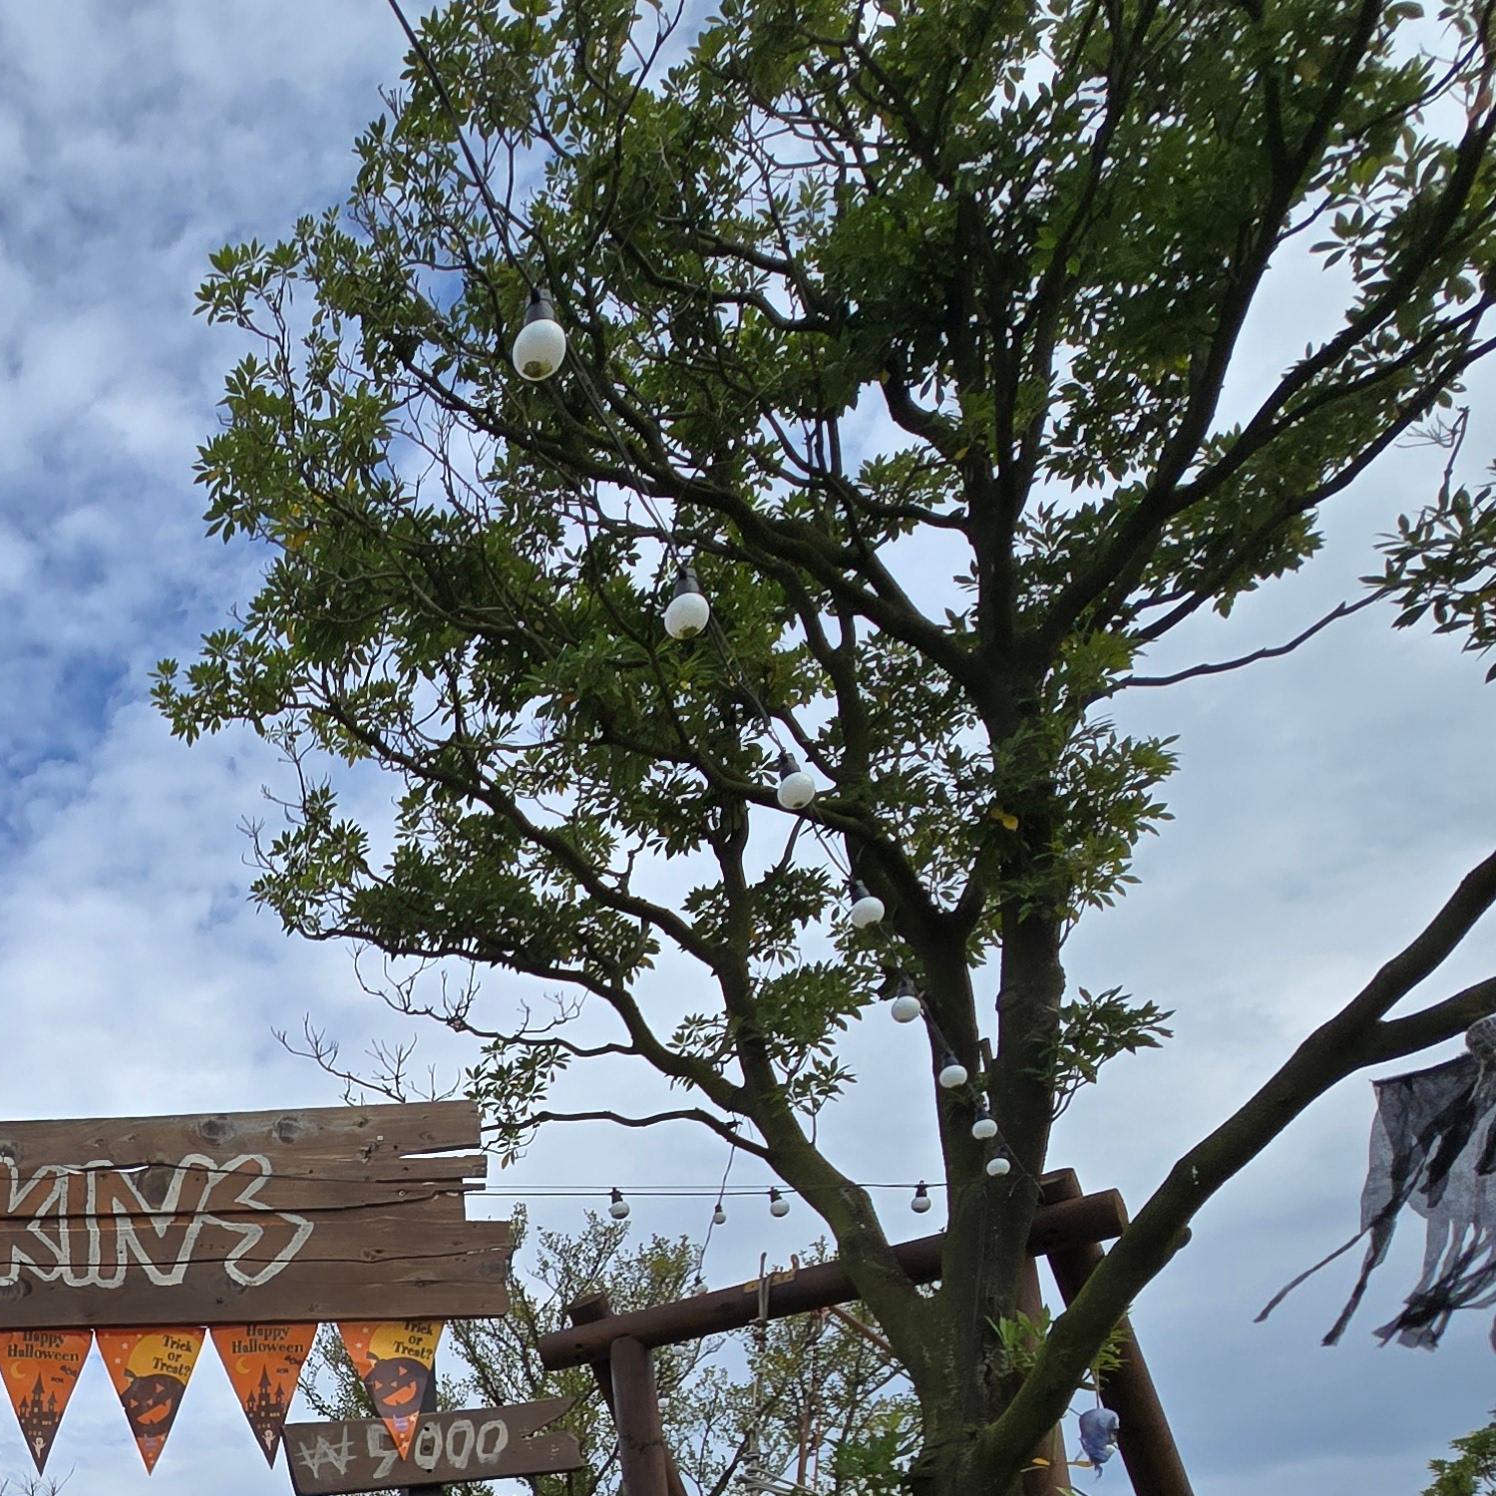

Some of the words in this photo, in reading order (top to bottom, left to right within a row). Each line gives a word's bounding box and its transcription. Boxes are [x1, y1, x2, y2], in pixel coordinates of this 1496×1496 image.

[246, 1324, 290, 1341] Happy
[403, 1320, 433, 1336] Trick
[24, 1332, 64, 1348] Happy
[163, 1334, 192, 1352] Trick
[231, 1338, 304, 1354] Halloween
[408, 1335, 423, 1346] or
[7, 1343, 79, 1361] Halloween
[167, 1352, 182, 1362] or
[393, 1340, 433, 1360] Treat?
[153, 1356, 191, 1377] Treat?
